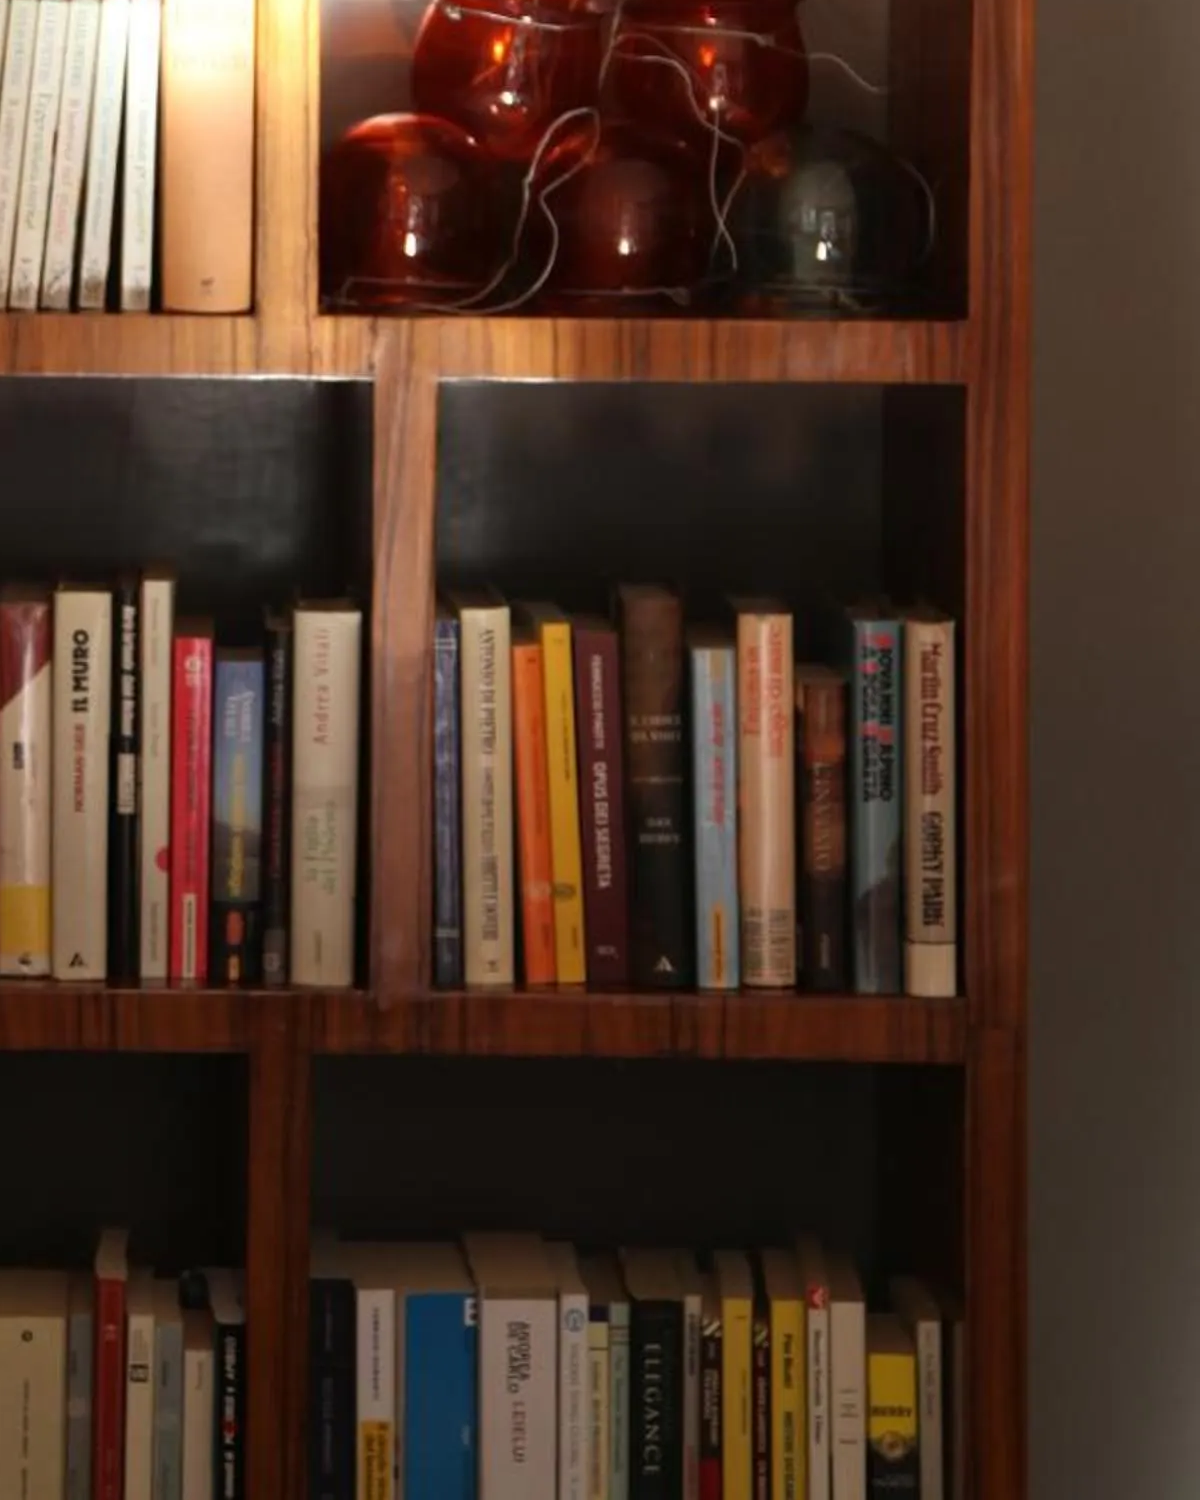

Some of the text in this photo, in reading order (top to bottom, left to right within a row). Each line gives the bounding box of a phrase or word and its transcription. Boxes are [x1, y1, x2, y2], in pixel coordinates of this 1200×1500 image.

[69, 628, 91, 714] IL MURO
[310, 628, 331, 746] Andrea Vitali
[920, 642, 944, 796] Martin Cruz Smith
[593, 760, 614, 890] OPUS DEI SEGRETA
[920, 810, 945, 927] GORKY PARK
[505, 1321, 520, 1394] DE CARLO
[518, 1321, 532, 1381] ANDREA
[643, 1342, 662, 1477] ELEGANCE
